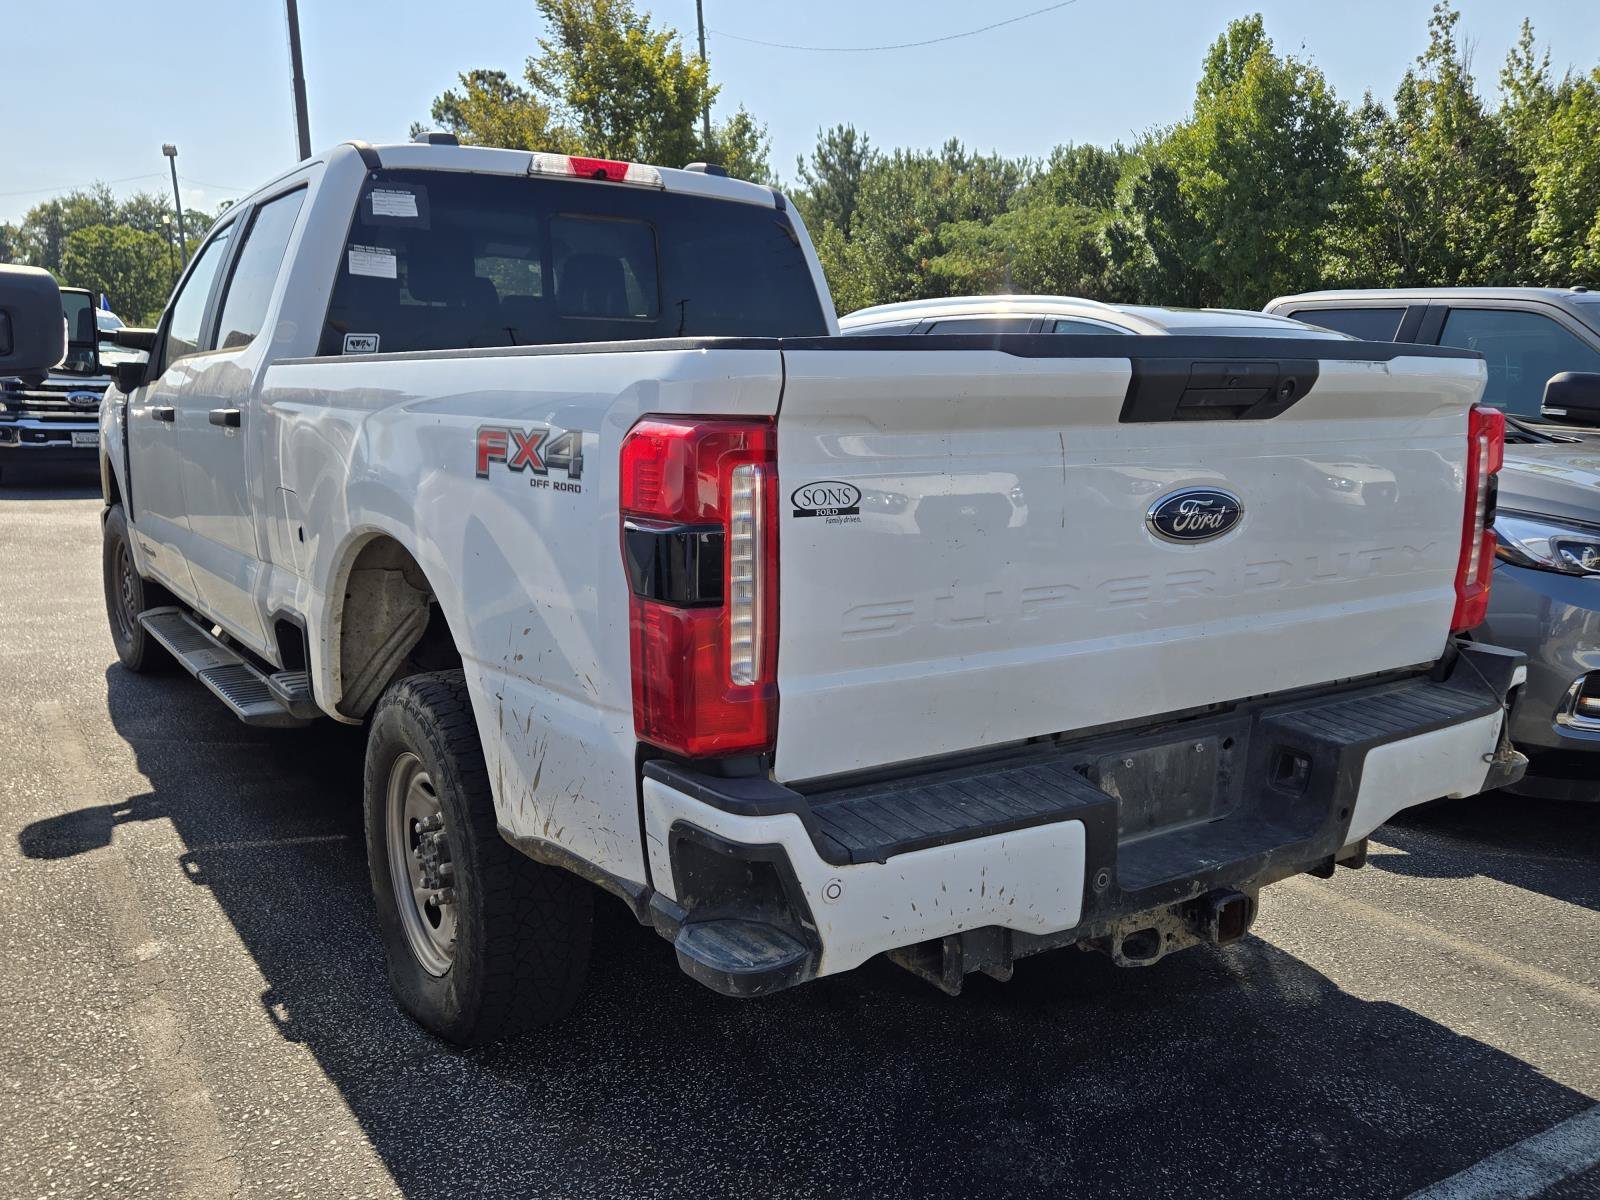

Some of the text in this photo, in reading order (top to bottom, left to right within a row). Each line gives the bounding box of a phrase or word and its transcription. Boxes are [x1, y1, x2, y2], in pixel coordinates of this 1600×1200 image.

[476, 424, 583, 480] FX4
[530, 478, 582, 493] OFF ROAD
[802, 488, 851, 507] SONS
[816, 508, 839, 516] FORD
[826, 516, 843, 525] Family
[1173, 499, 1226, 532] Ford
[840, 541, 1438, 640] SUPER DUTY
